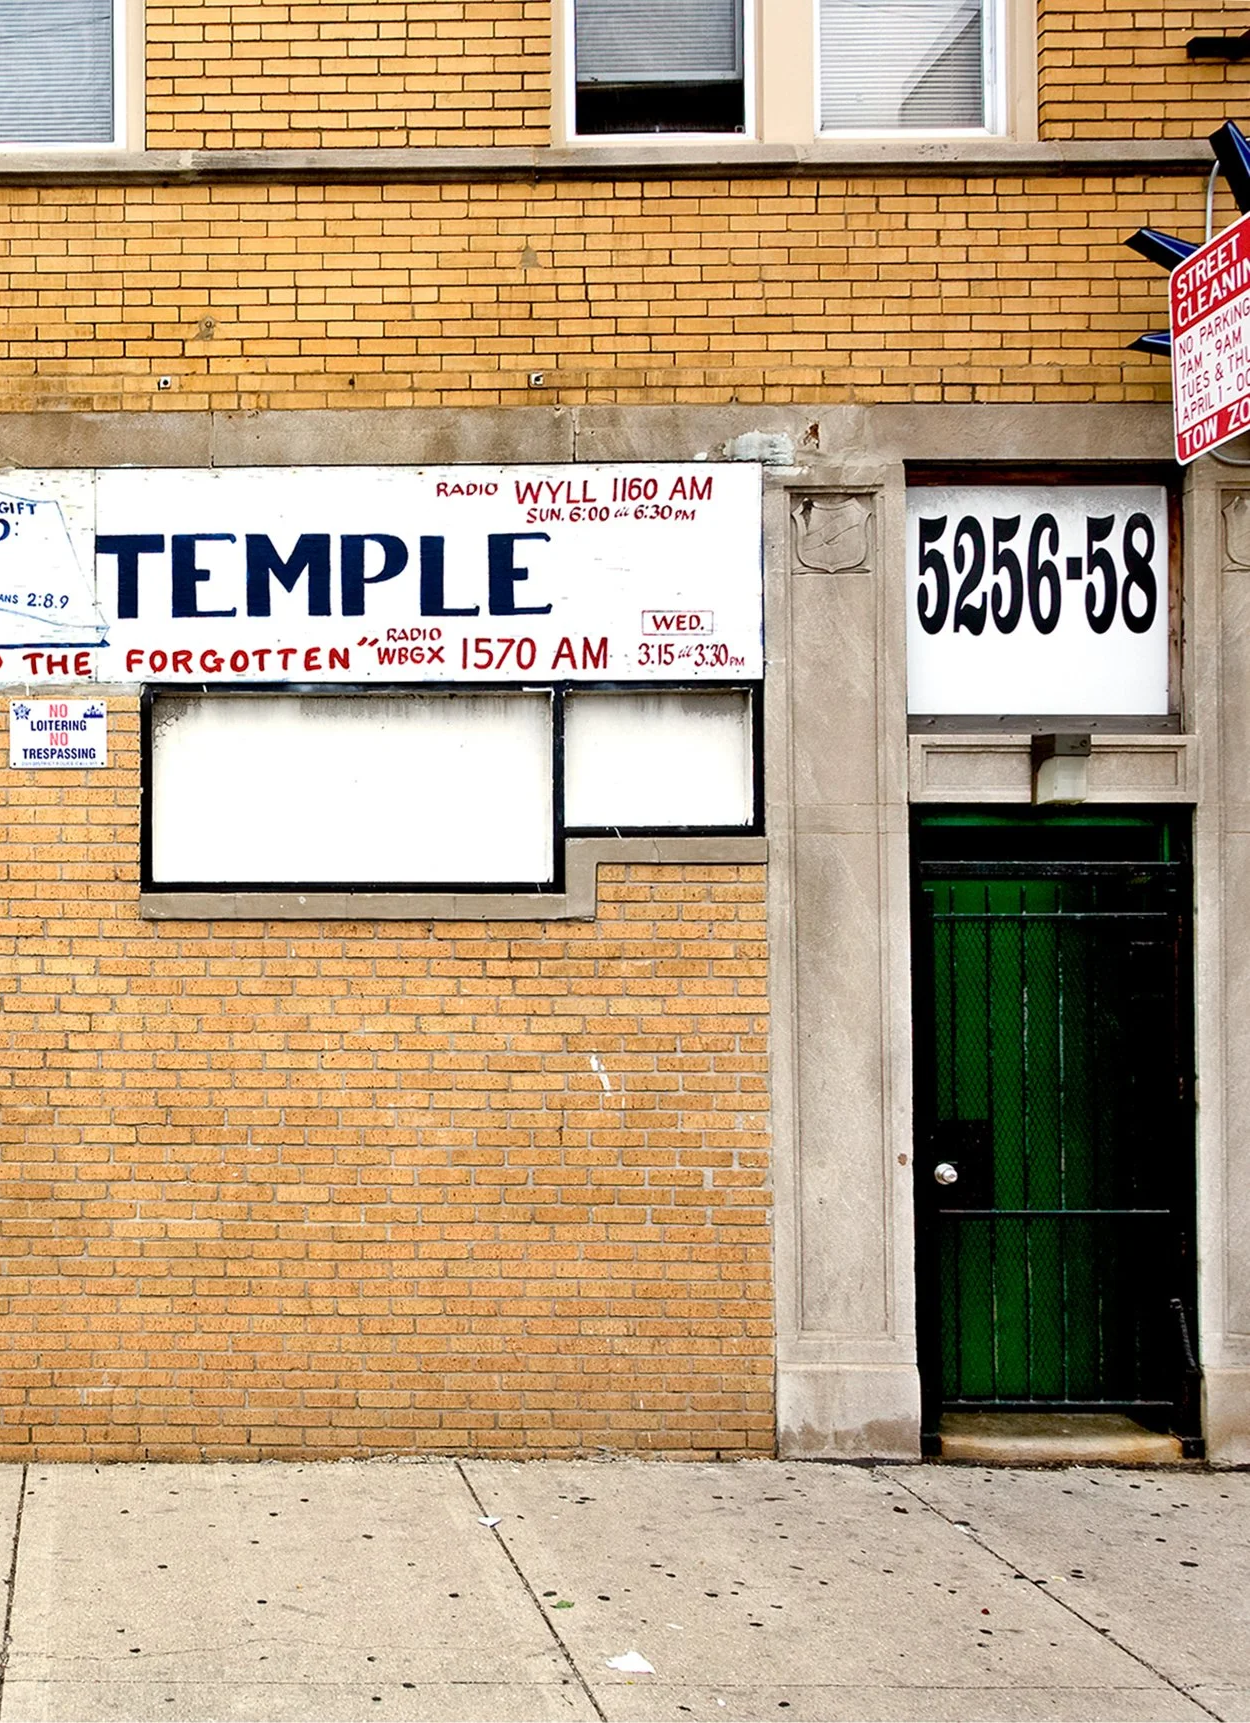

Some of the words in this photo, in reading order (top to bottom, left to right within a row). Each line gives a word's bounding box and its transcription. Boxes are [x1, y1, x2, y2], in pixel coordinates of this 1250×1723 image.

[1176, 232, 1241, 300] STREET
[1179, 335, 1194, 359] NO
[1199, 297, 1250, 345] PARKING
[1180, 352, 1203, 380] 7AM
[1215, 326, 1242, 357] 9AM
[1180, 370, 1210, 402] TUES
[1215, 362, 1224, 382] &
[1182, 392, 1215, 425] APRIL
[1182, 415, 1218, 456] TOW
[436, 482, 498, 497] RADIO
[514, 479, 597, 504] WYLL
[612, 477, 658, 502] 1160
[669, 476, 713, 500] AM
[526, 507, 565, 524] SUN.
[569, 506, 610, 522] 6:00
[634, 504, 672, 520] 6:30
[674, 509, 696, 521] PM
[96, 532, 552, 618] TEMPLE
[917, 512, 1157, 636] 5256-58
[387, 628, 442, 642] RADIO
[652, 615, 705, 632] WED.
[23, 652, 93, 676] THE
[377, 646, 445, 664] WBGX
[462, 637, 537, 669] 1570
[551, 637, 608, 669] AM
[637, 642, 675, 666] 3:15
[694, 643, 729, 667] 3:30
[730, 656, 745, 667] PM
[49, 703, 68, 718] NO
[30, 720, 87, 731] LOITERING
[50, 732, 69, 746] NO
[22, 748, 96, 759] TRESPASSING
